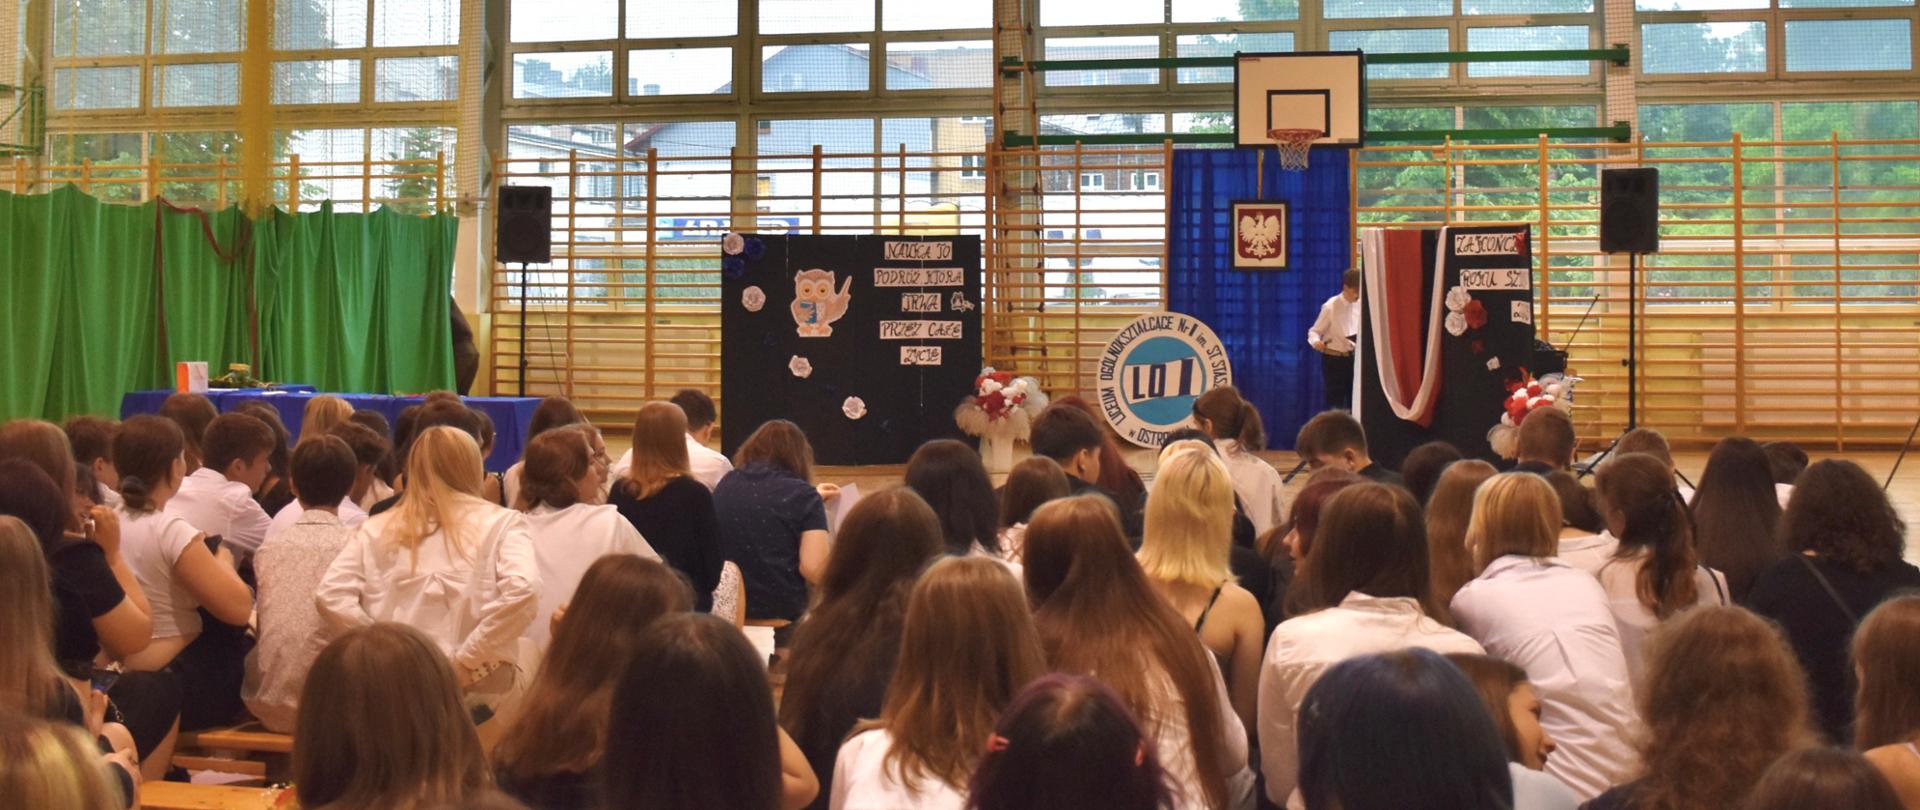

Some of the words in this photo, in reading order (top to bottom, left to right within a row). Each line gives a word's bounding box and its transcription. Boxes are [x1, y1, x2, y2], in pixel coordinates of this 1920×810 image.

[886, 243, 931, 259] NAUKA
[937, 243, 951, 259] TO
[903, 294, 939, 311] TRWA
[881, 321, 923, 338] PRZEZ
[1101, 386, 1126, 425] LICEUM
[1177, 317, 1189, 333] Nr
[1132, 364, 1167, 400] LO
